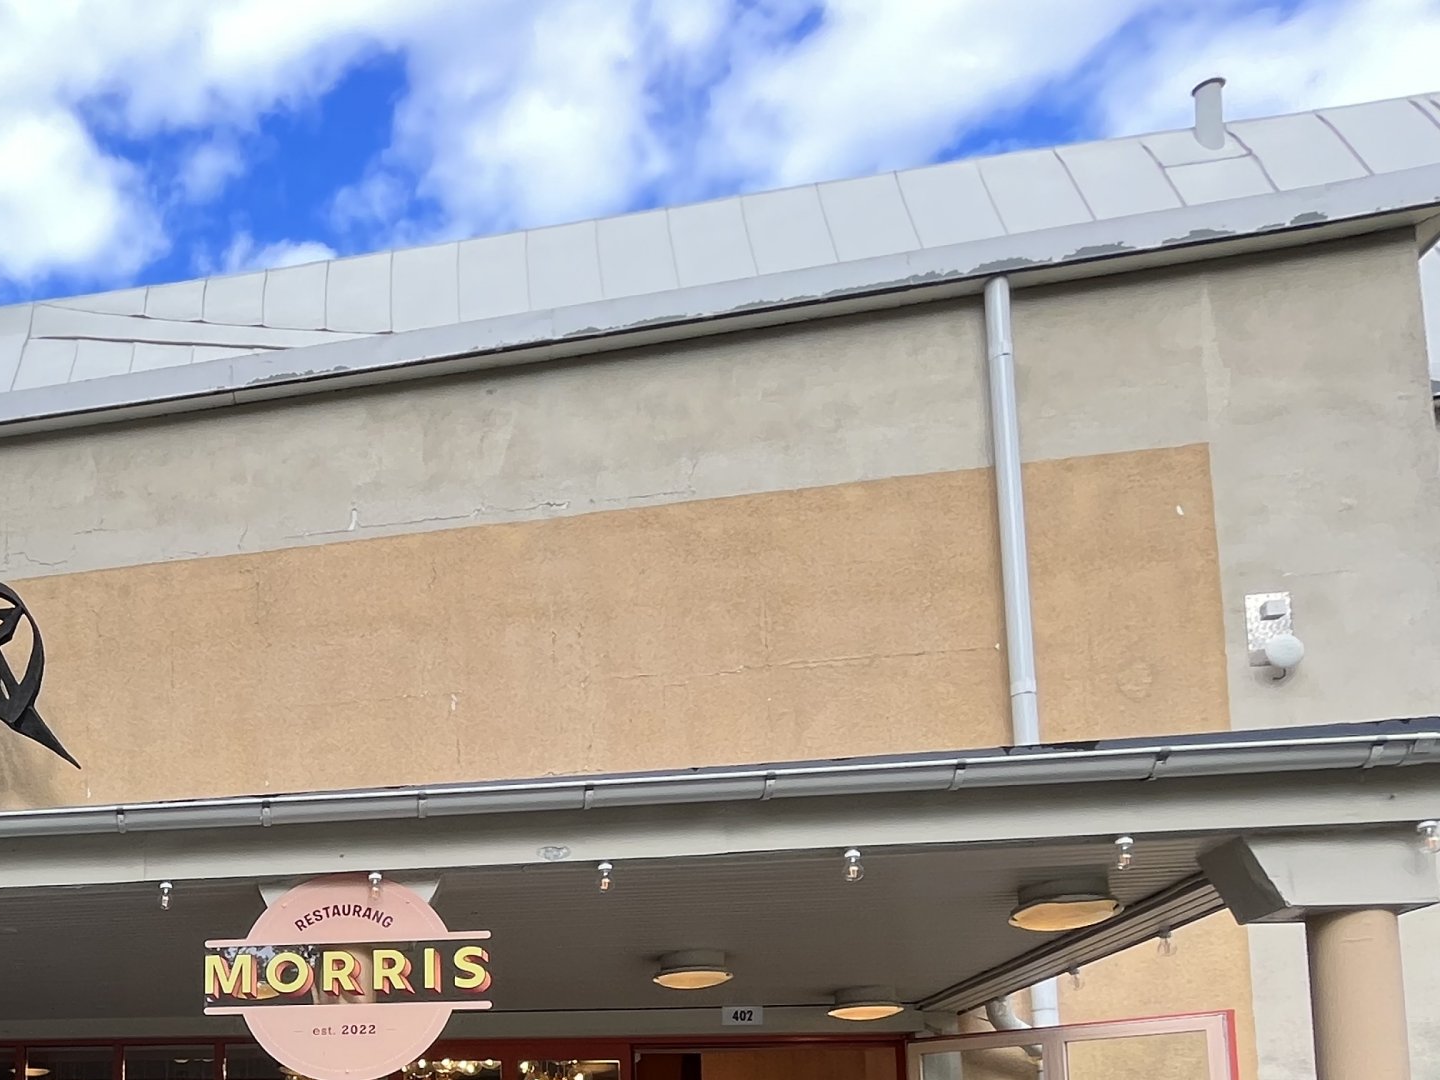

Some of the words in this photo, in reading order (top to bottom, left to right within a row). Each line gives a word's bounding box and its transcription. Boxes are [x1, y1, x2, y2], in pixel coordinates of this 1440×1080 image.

[294, 904, 394, 932] RESTAURANG
[204, 946, 492, 999] MORRIS
[732, 1010, 753, 1021] 402
[312, 1026, 336, 1036] est.
[341, 1024, 377, 1036] 2022
